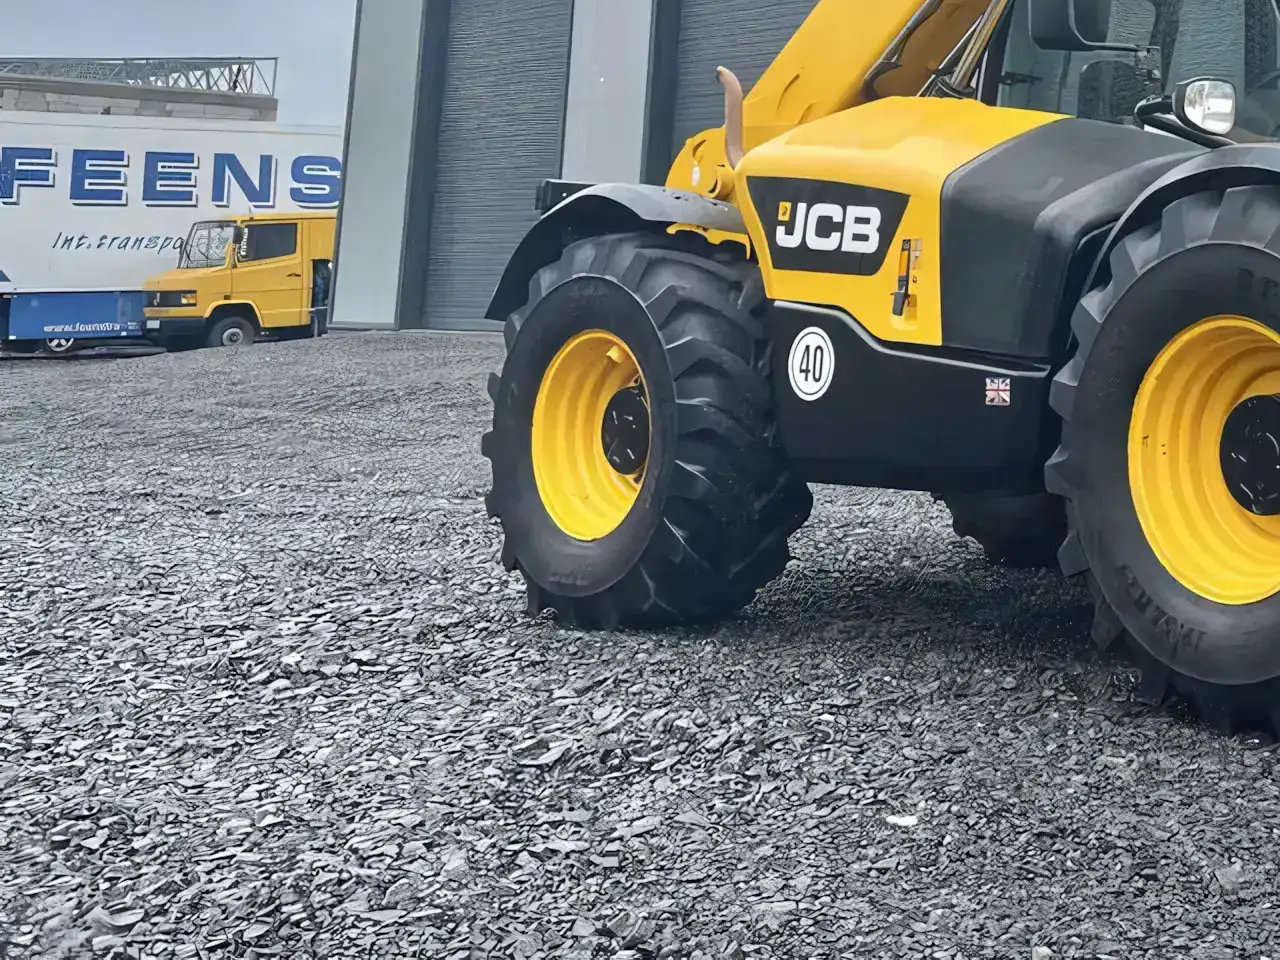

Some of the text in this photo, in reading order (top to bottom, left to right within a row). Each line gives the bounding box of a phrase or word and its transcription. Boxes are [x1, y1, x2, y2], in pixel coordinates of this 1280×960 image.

[1, 146, 341, 209] FEENS
[776, 202, 882, 254] JCB
[799, 344, 823, 383] 40
